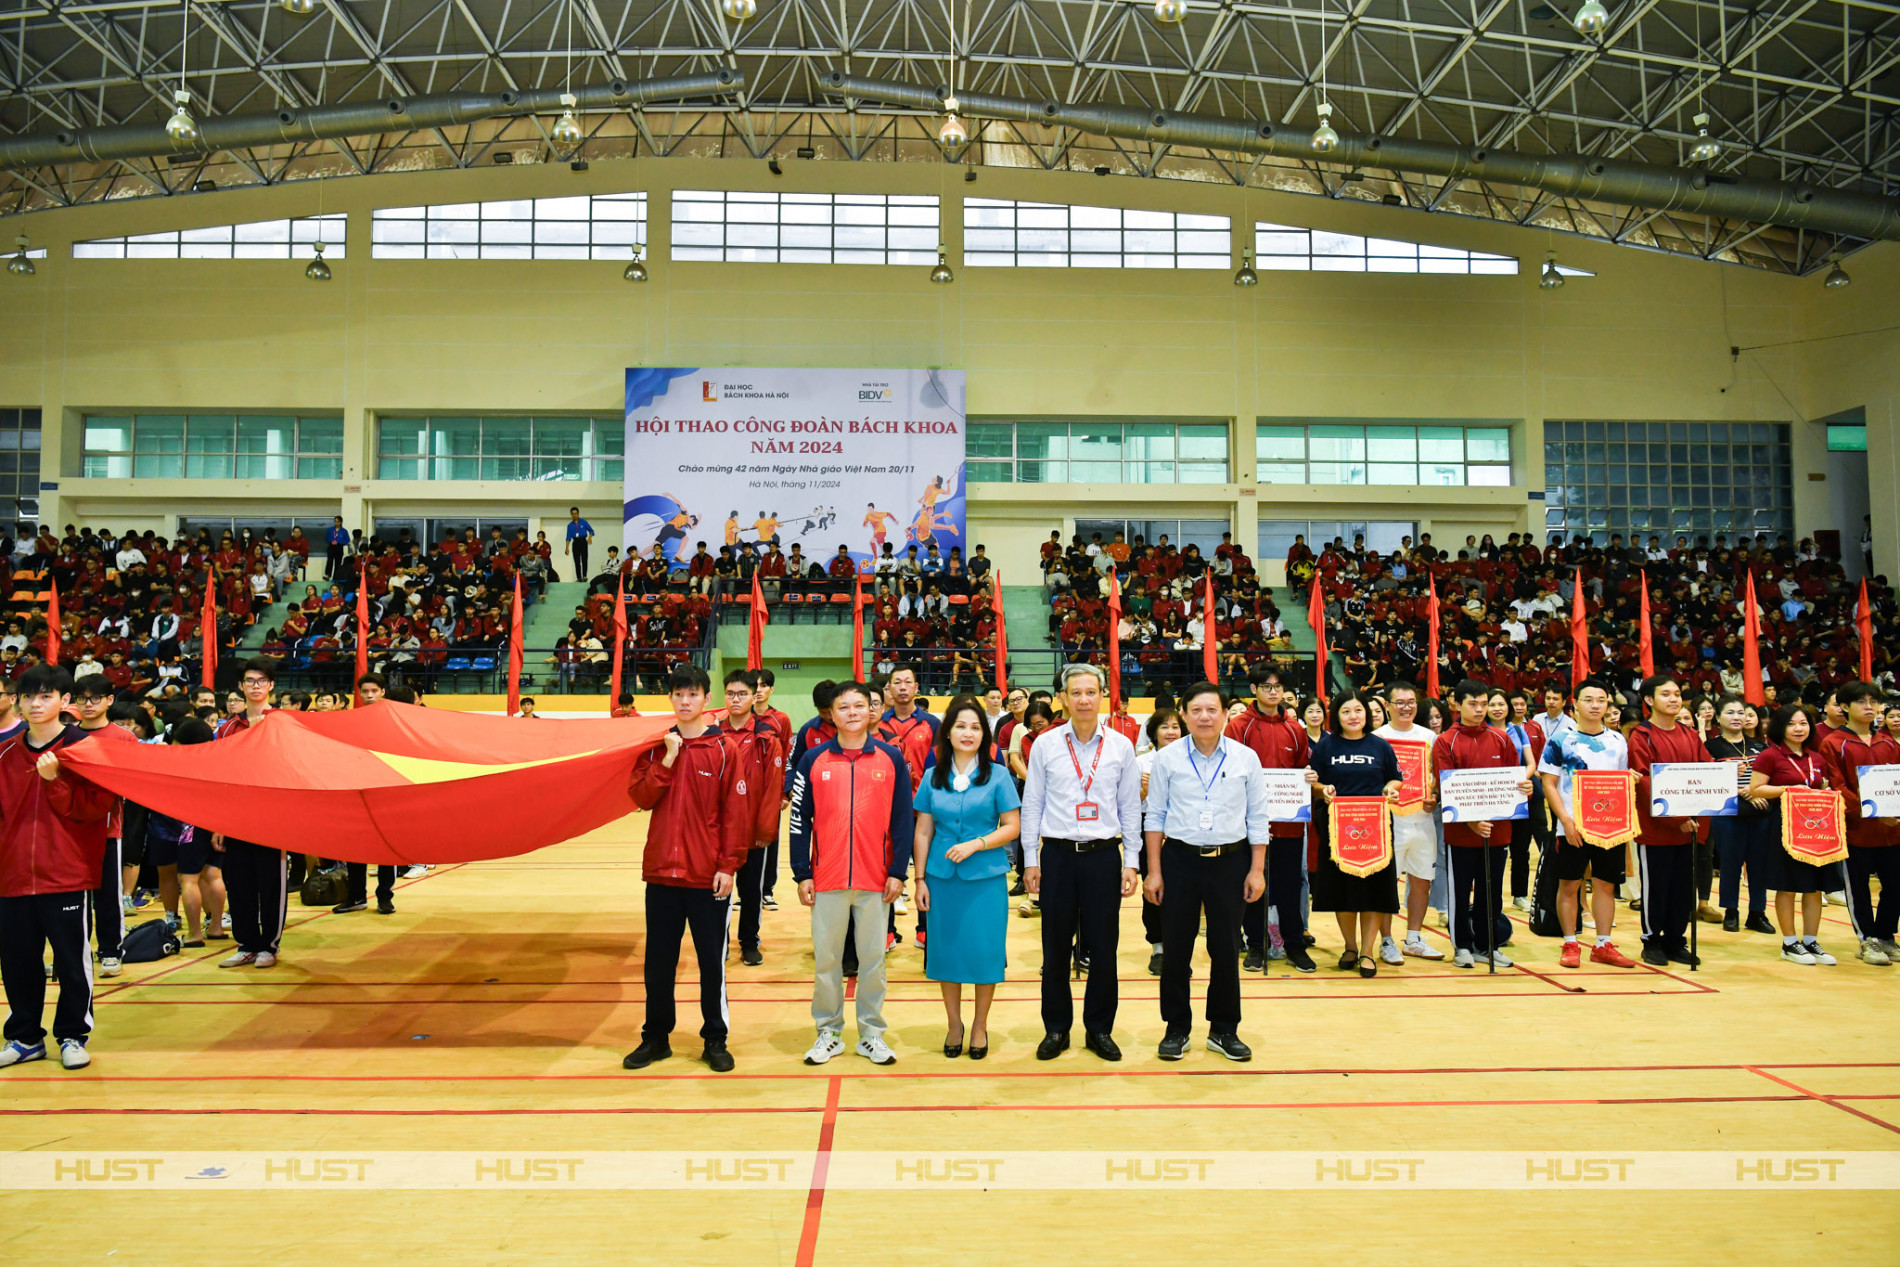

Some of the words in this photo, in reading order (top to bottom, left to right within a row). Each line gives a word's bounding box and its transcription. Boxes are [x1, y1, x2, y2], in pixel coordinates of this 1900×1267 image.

[858, 390, 883, 400] BIDV
[635, 416, 670, 436] HỘI
[675, 420, 728, 432] THAO
[733, 416, 786, 433] CÔNG
[790, 416, 844, 433] ĐOÀN
[848, 416, 898, 433] BÁCH
[904, 421, 958, 434] KHOA
[750, 438, 794, 453] NĂM
[800, 441, 843, 454] 2024
[678, 464, 704, 472] Chào
[706, 464, 733, 474] mừng
[772, 465, 798, 474] Ngày
[820, 465, 842, 474] giáo
[844, 465, 862, 474] Việt
[888, 466, 914, 474] 20/11
[781, 481, 806, 489] tháng
[1331, 755, 1375, 765] HUST
